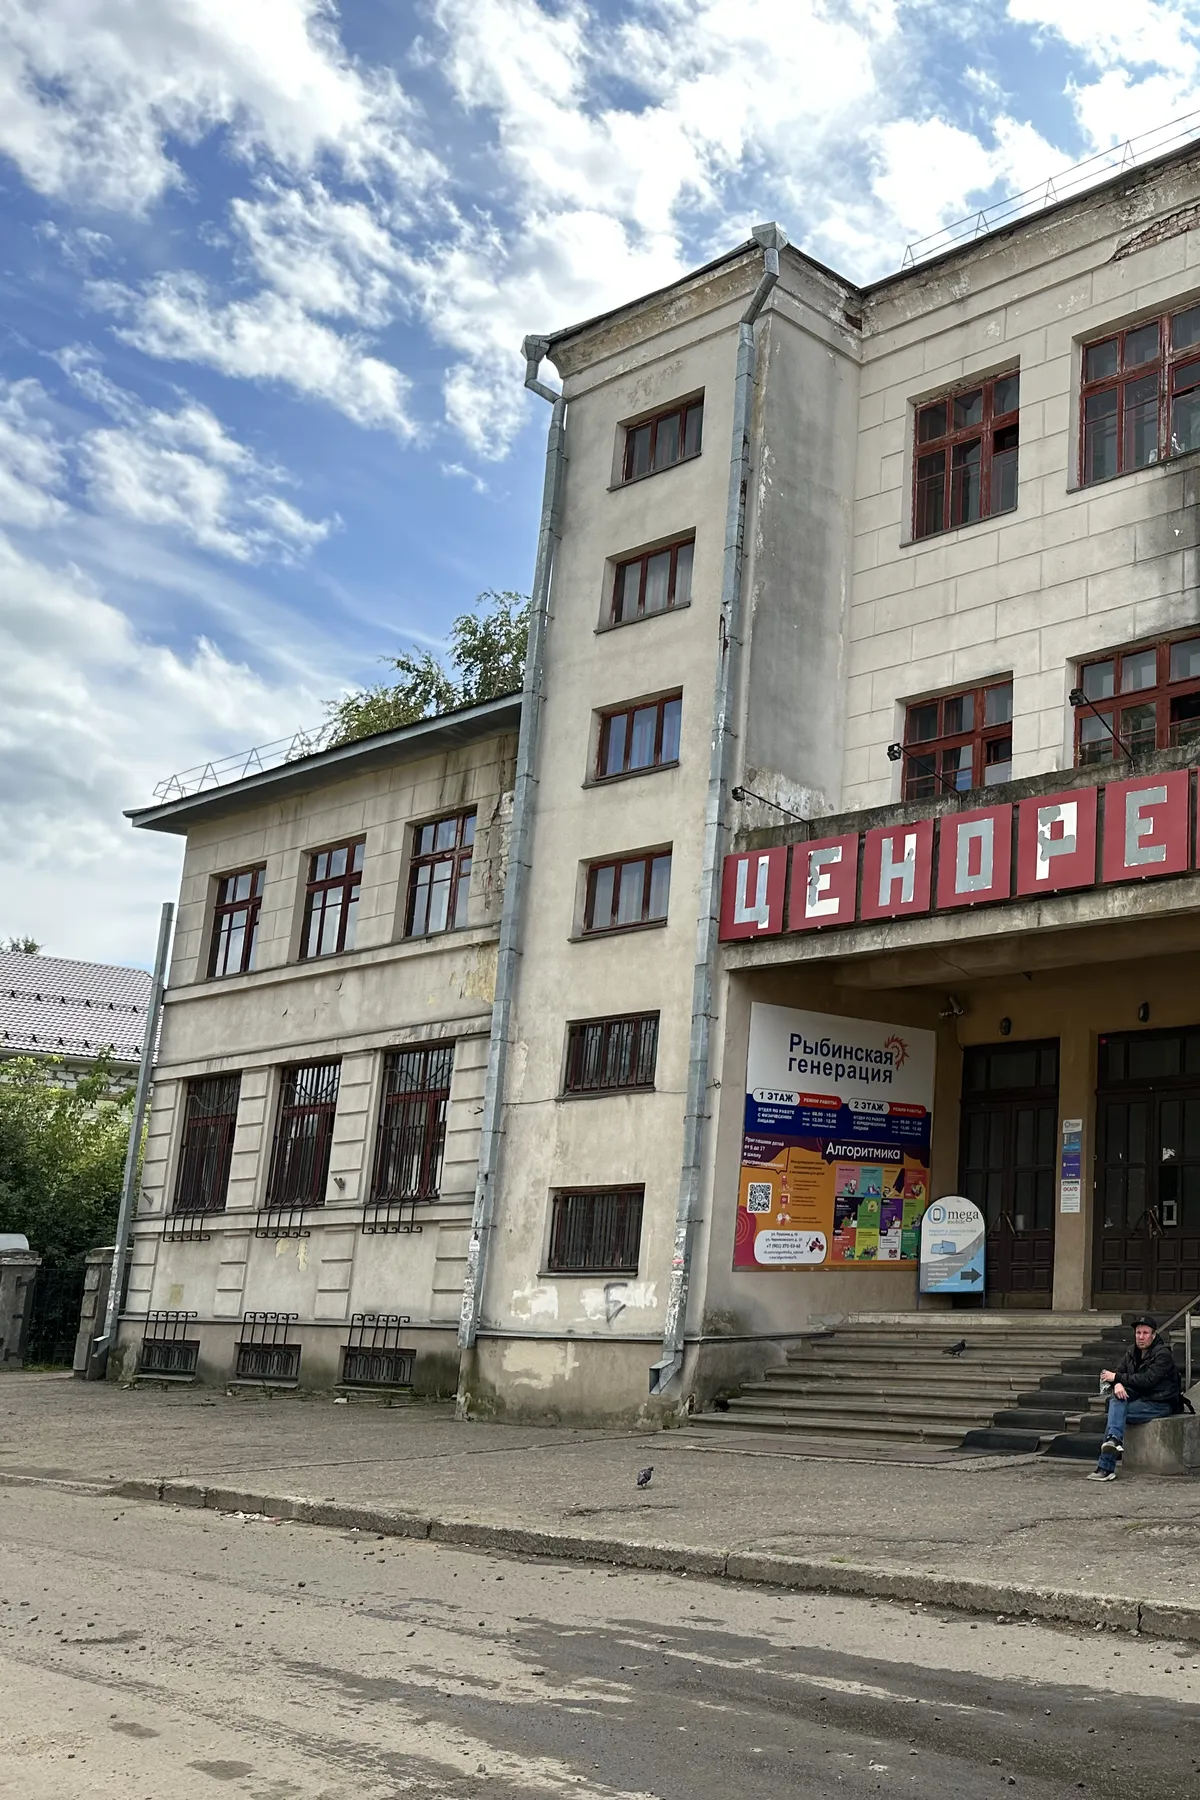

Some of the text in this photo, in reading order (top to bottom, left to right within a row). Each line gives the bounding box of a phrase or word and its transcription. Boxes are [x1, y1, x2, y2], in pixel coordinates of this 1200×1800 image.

[789, 1033, 894, 1066] Рыбинская
[788, 1057, 893, 1084] генерация
[767, 1092, 794, 1102] ЭТАЖ
[854, 1101, 884, 1111] 2 ЭТАЖ
[826, 1142, 901, 1159] Алгоритмика
[928, 1205, 979, 1224] Omega
